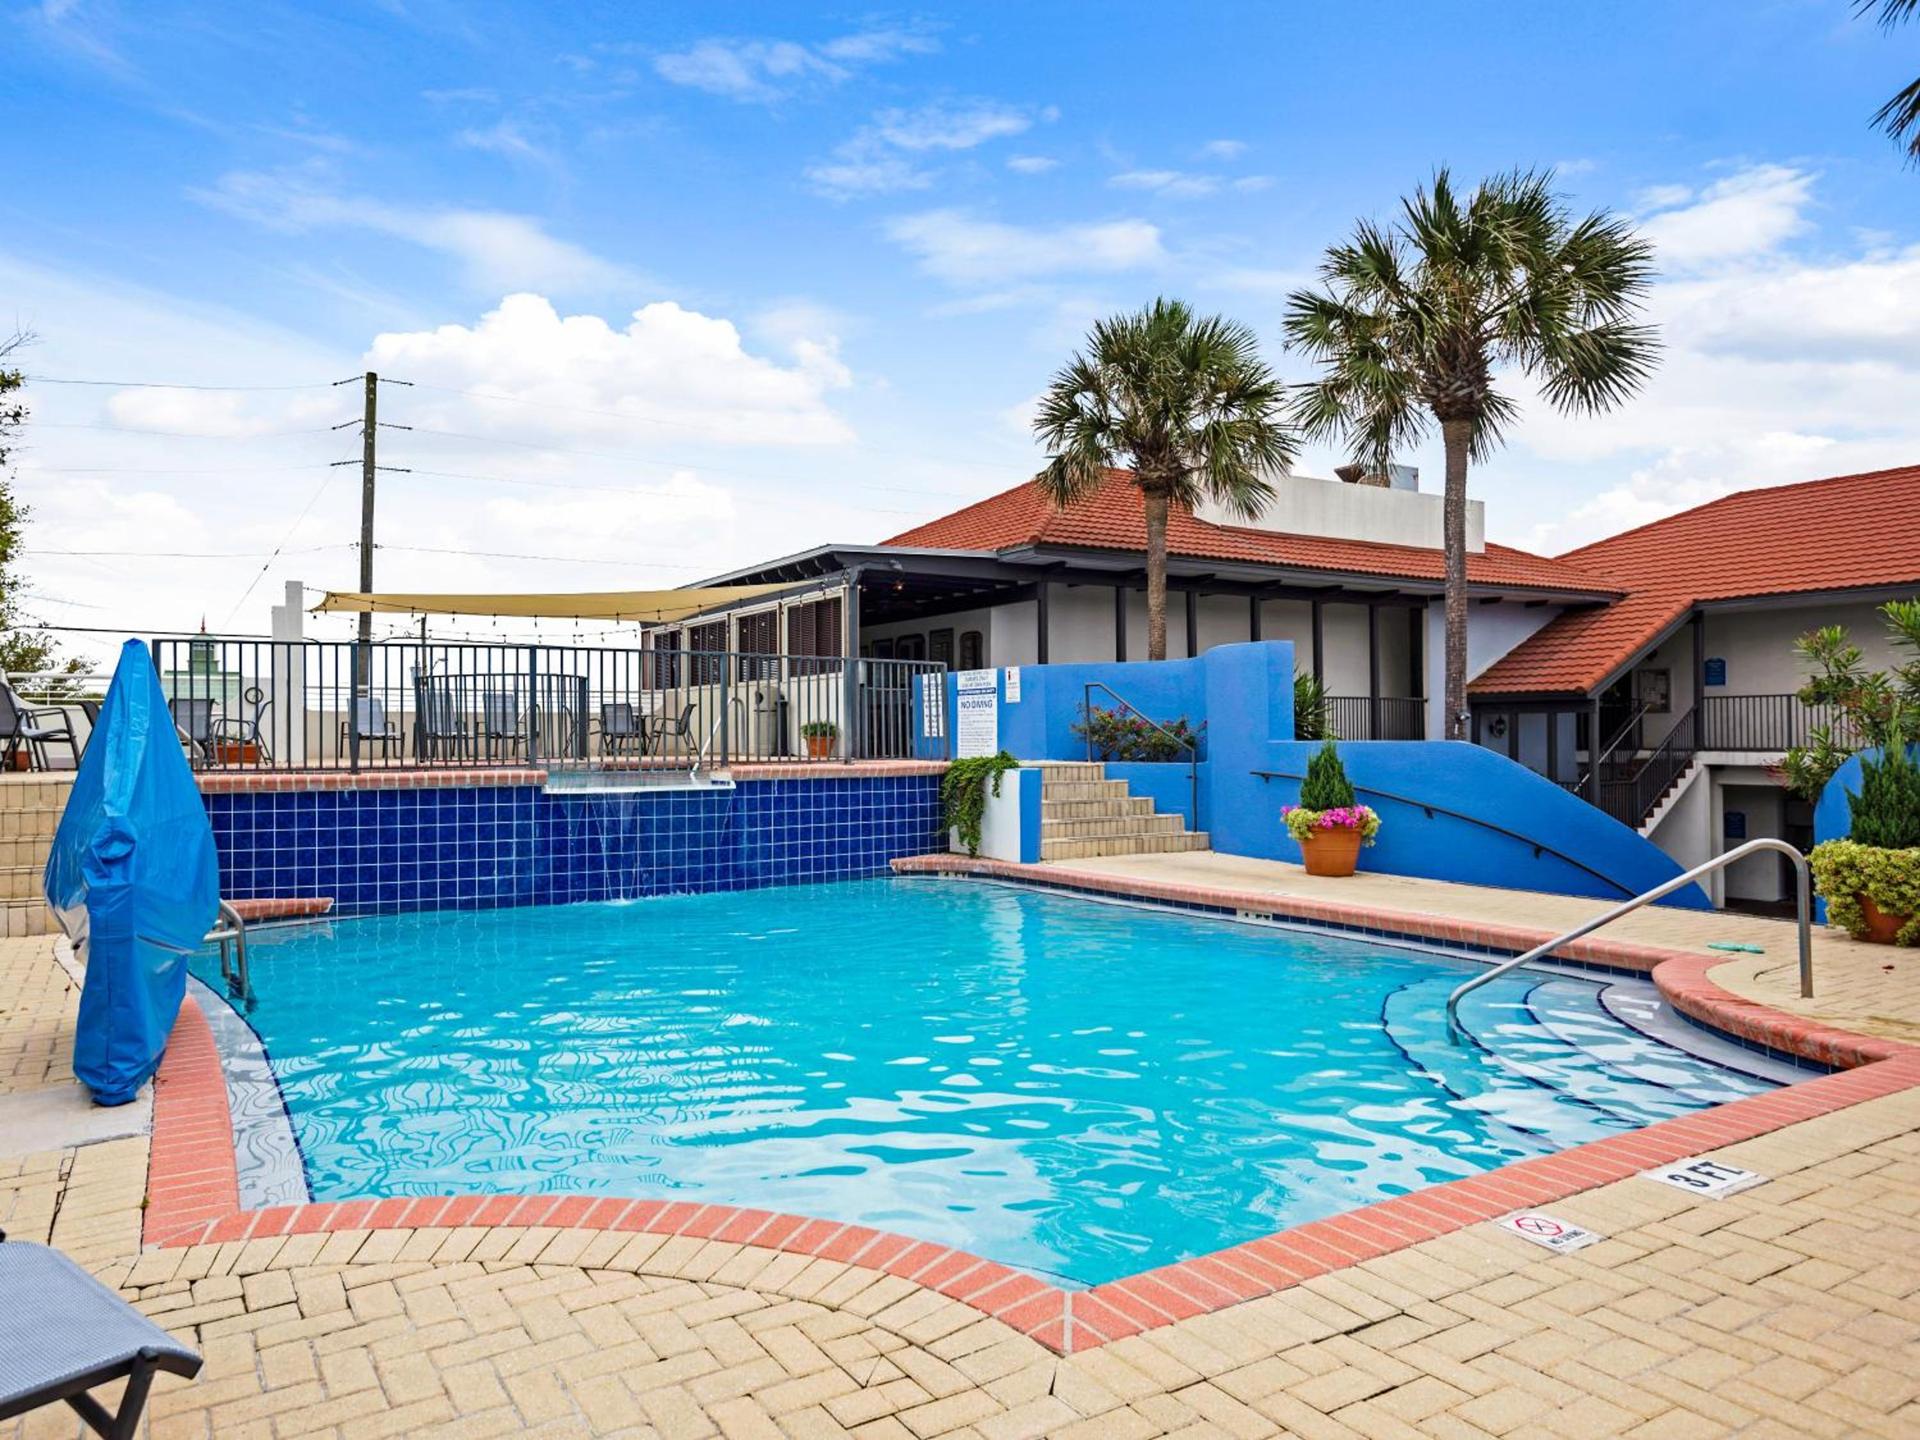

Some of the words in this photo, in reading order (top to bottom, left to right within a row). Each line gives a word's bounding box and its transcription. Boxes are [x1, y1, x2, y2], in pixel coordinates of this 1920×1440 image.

[961, 701, 970, 709] NO
[971, 699, 993, 709] DIVING
[1686, 1161, 1745, 1181] FT
[1667, 1174, 1710, 1188] 3
